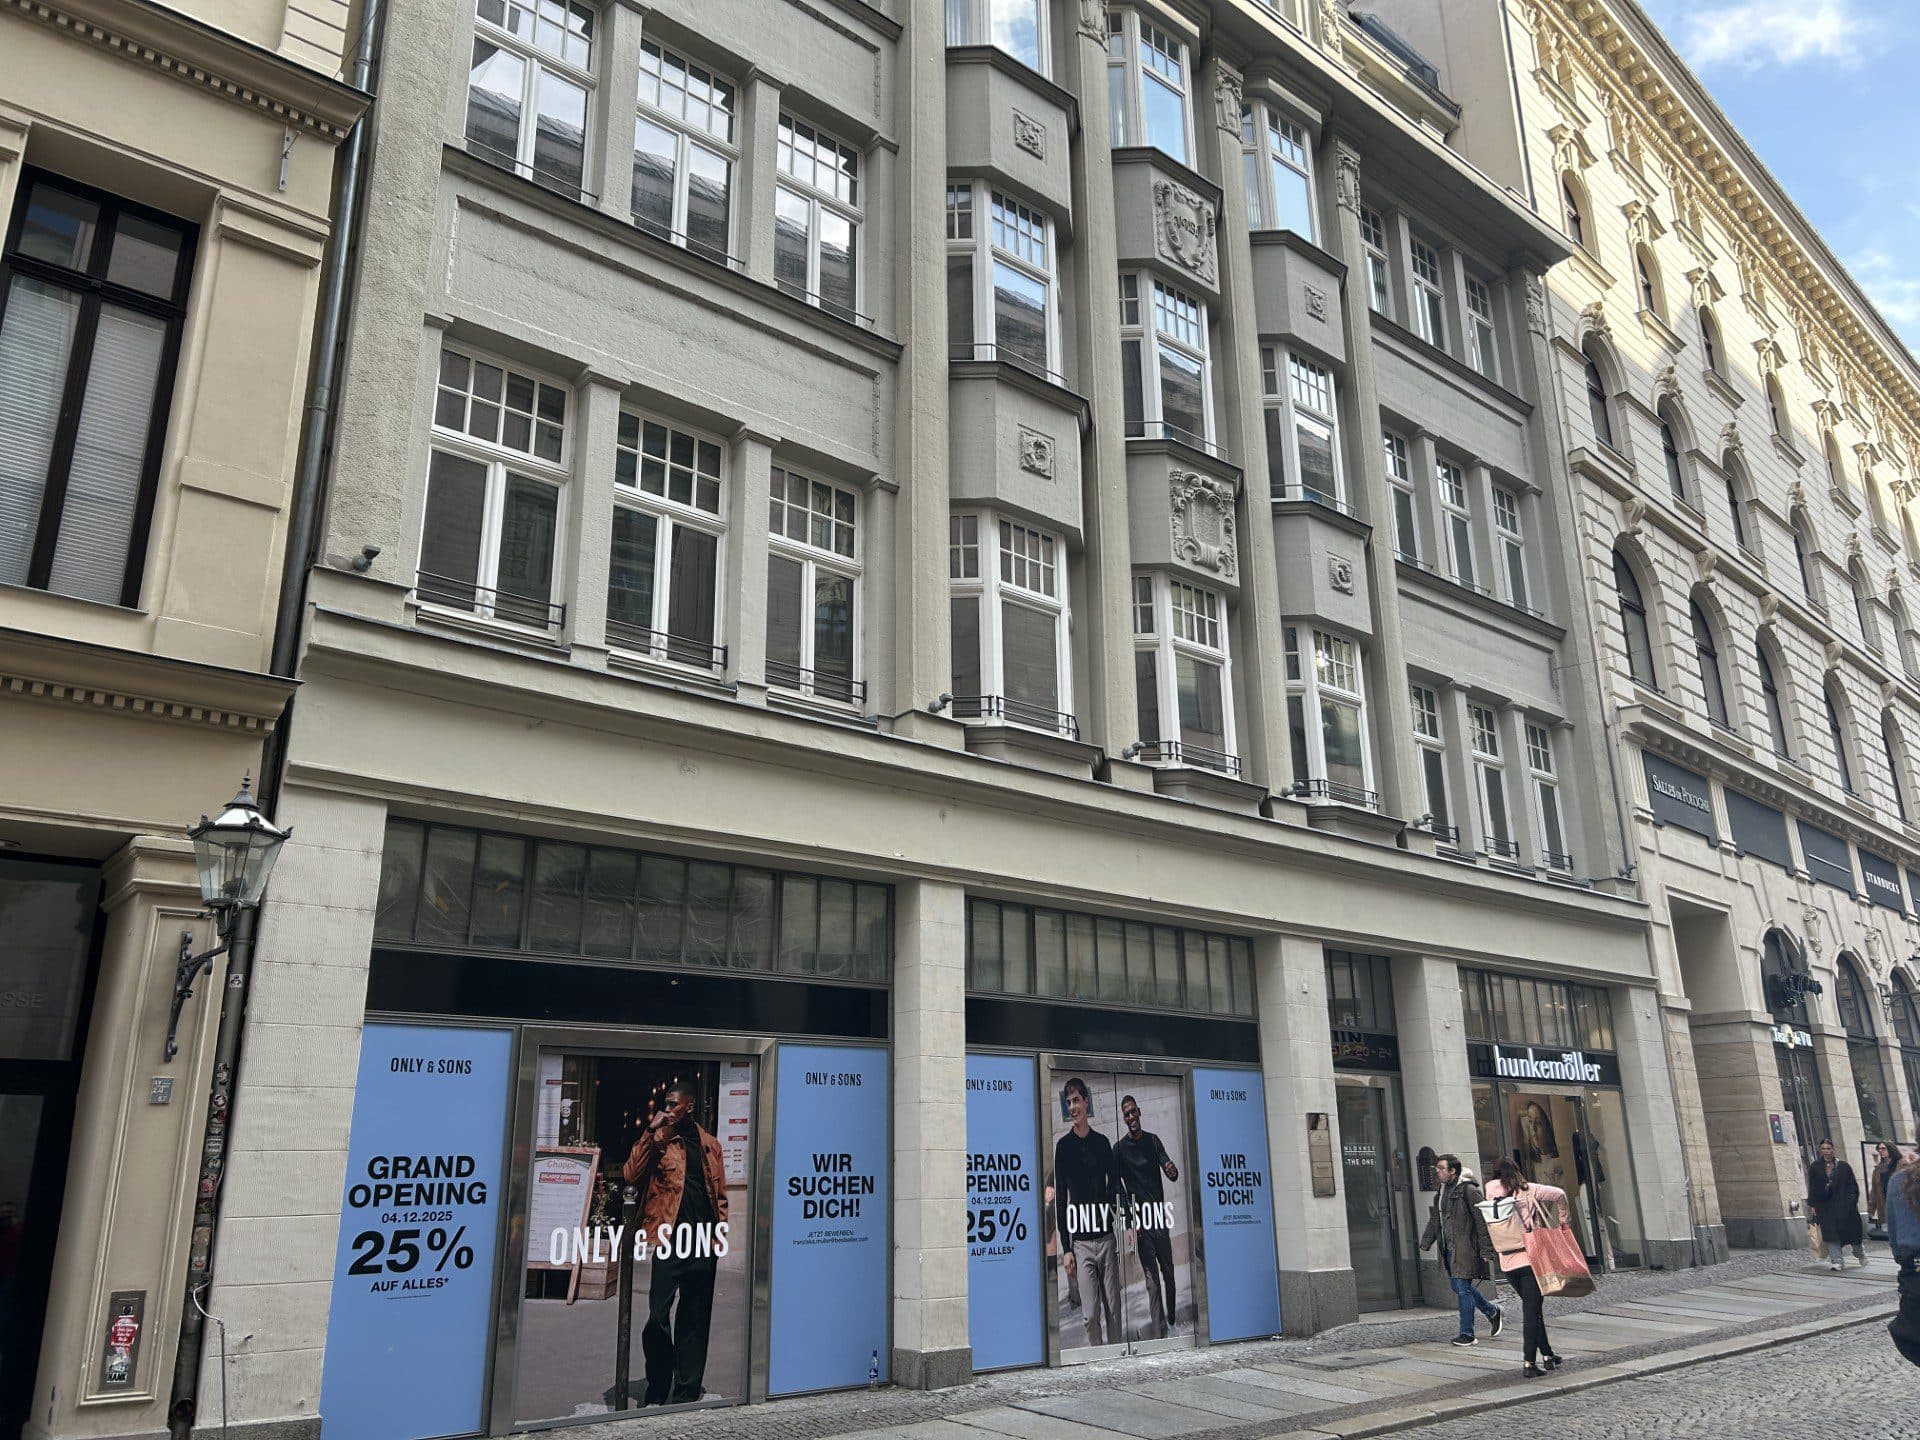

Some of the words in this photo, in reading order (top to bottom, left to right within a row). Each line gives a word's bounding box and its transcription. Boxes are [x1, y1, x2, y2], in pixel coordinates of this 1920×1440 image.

[390, 1057, 424, 1073] ONLY
[427, 1061, 435, 1074] &
[438, 1059, 472, 1075] SONS
[1494, 1044, 1601, 1082] hunkemöller
[805, 1071, 828, 1086] ONLY
[830, 1074, 836, 1086] &
[837, 1072, 862, 1087] SONS
[966, 1078, 985, 1091] ONLY
[992, 1079, 1013, 1092] SONS
[1210, 1089, 1225, 1100] ONLY
[1231, 1090, 1247, 1101] SONS
[367, 1155, 476, 1180] GRAND
[812, 1153, 853, 1173] WIR
[1220, 1153, 1247, 1170] WIR
[787, 1175, 875, 1197] SUCHEN
[967, 1174, 1030, 1193] PENING
[1207, 1171, 1262, 1188] SUCHEN
[348, 1181, 487, 1209] OPENING
[971, 1195, 1012, 1205] 04.12.2025
[1218, 1189, 1254, 1206] DICH!
[381, 1210, 453, 1224] 04.12.2025
[803, 1198, 861, 1220] DICH!
[1066, 1203, 1109, 1234] ONLY
[1131, 1202, 1175, 1231] SONS
[348, 1225, 474, 1276] 25%
[549, 1224, 625, 1266] ONLY
[633, 1229, 648, 1261] &
[656, 1221, 730, 1260] SONS
[971, 1247, 987, 1257] AUF
[370, 1280, 399, 1293] AUF
